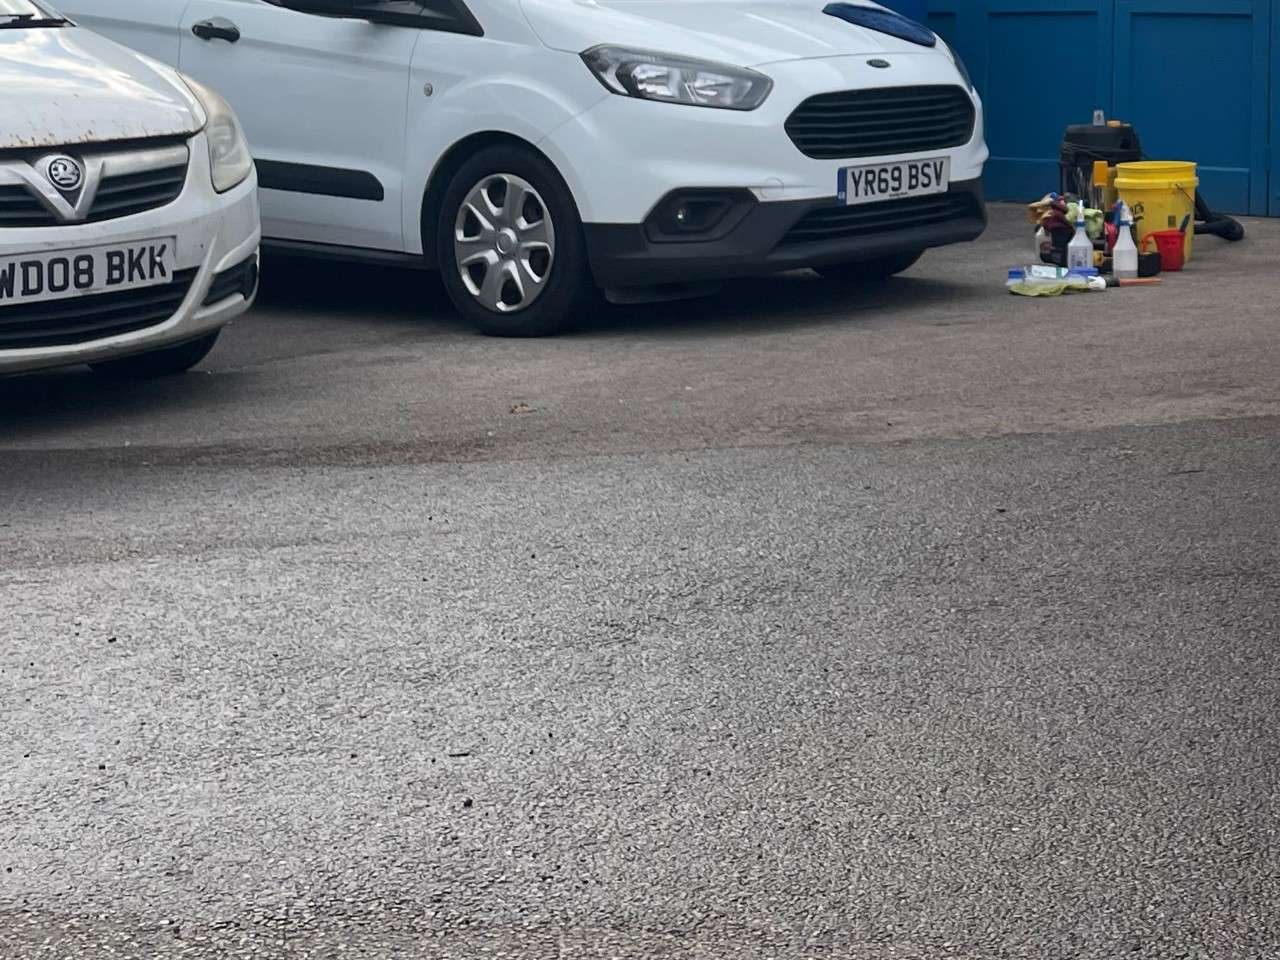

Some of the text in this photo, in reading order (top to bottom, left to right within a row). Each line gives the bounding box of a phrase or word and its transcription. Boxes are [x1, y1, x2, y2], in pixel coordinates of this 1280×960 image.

[851, 161, 944, 197] YR69 BSV
[0, 243, 168, 299] WD08 BKK
